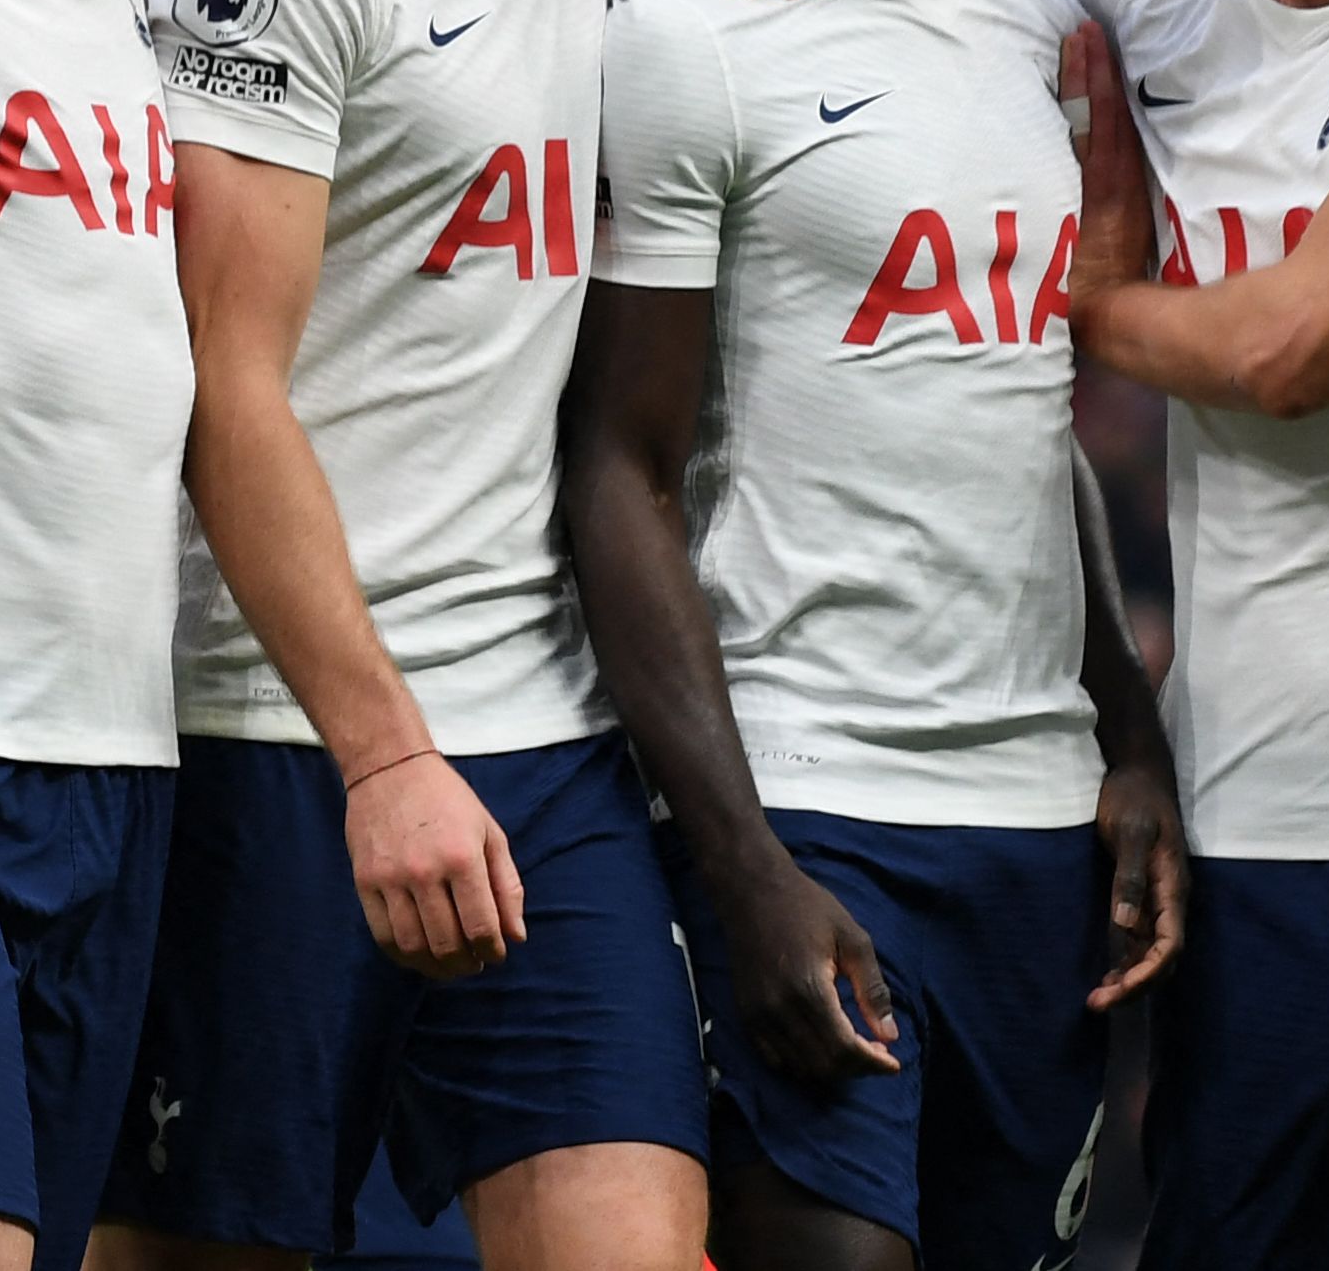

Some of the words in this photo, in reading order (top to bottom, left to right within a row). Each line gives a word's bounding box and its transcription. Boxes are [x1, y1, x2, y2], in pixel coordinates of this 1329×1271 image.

[175, 47, 209, 72] No
[212, 57, 276, 84] room
[205, 75, 285, 105] racism
[417, 139, 579, 281] AI
